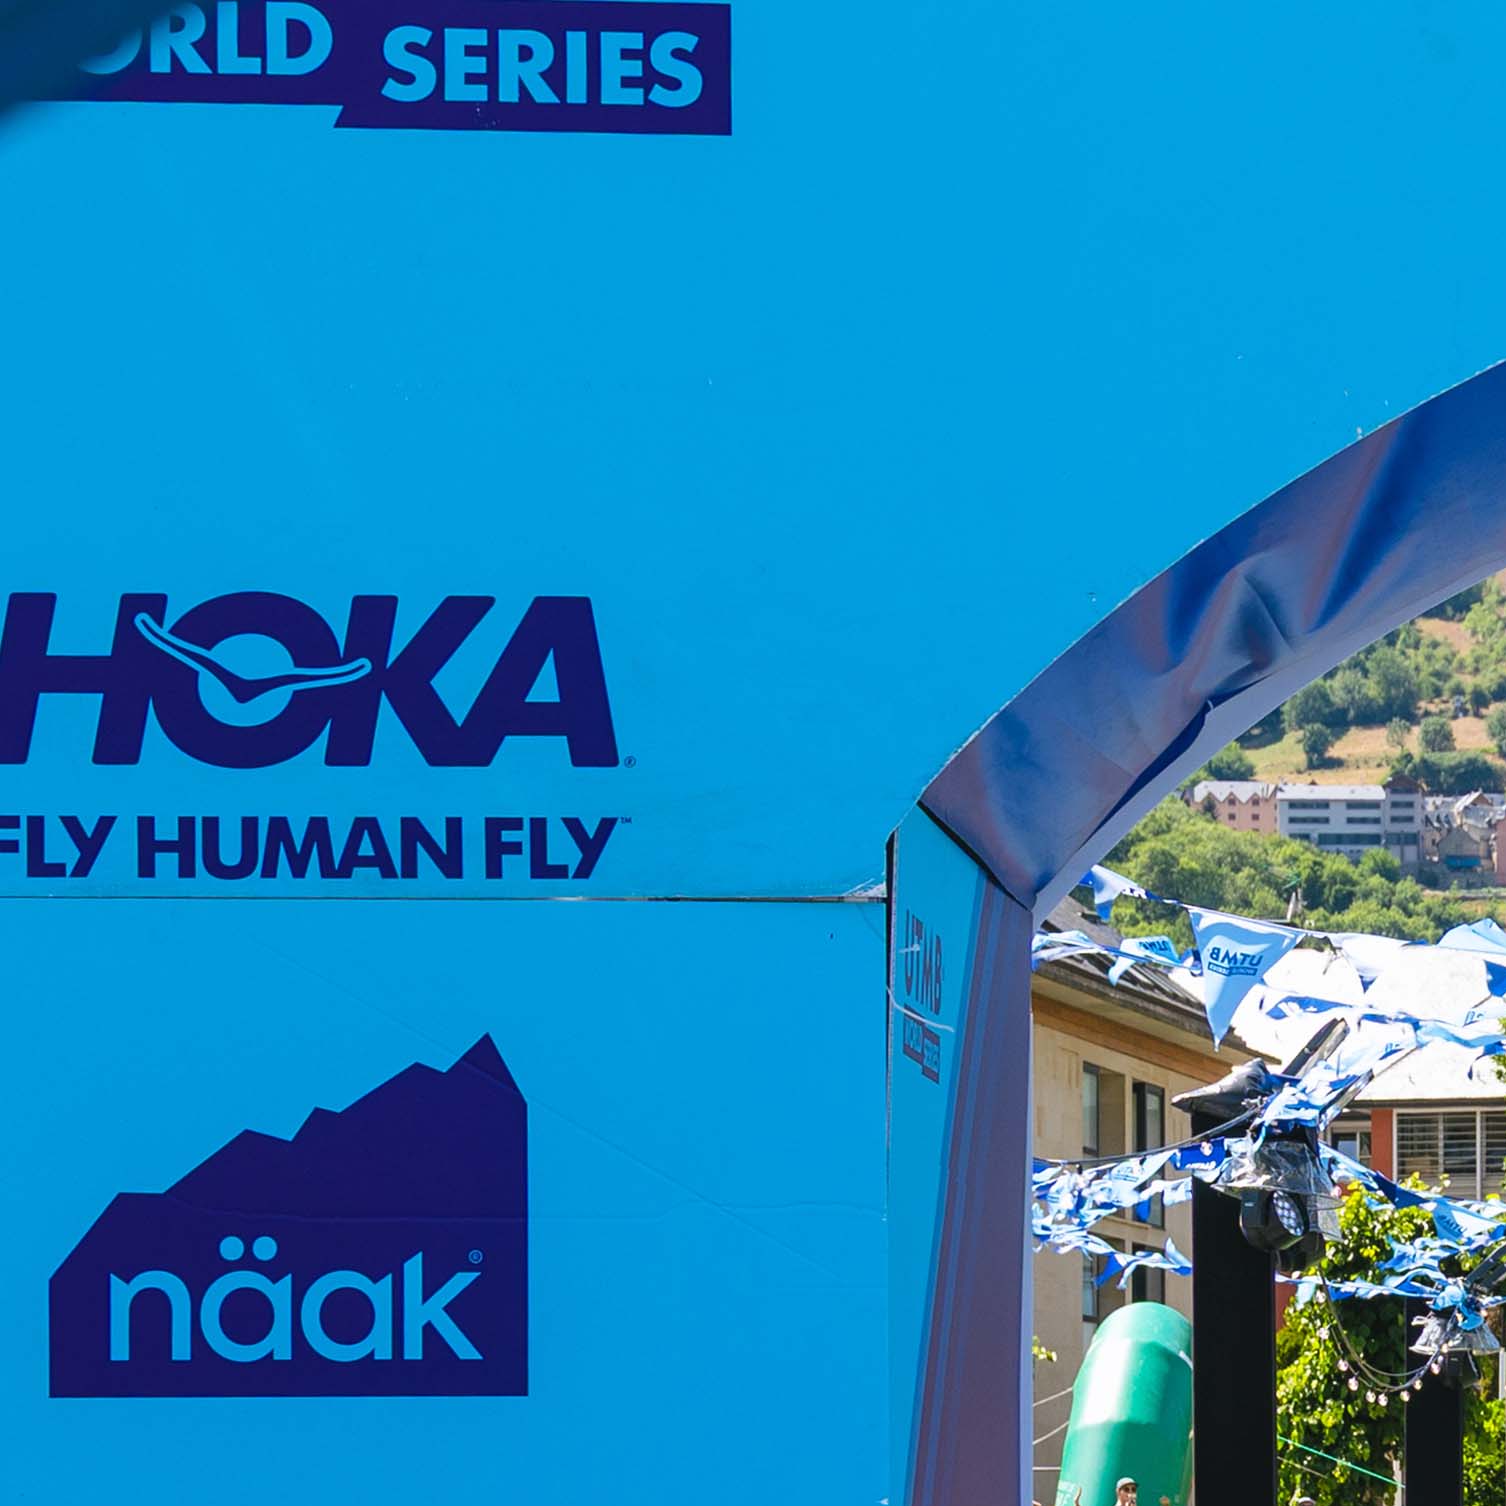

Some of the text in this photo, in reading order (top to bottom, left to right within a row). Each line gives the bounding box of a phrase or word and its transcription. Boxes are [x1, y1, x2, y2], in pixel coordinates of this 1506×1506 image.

[381, 26, 704, 108] SERIES
[0, 591, 621, 769] HOKA
[137, 816, 463, 880] HUMAN
[486, 817, 619, 879] FLY
[109, 1235, 484, 1362] näak
